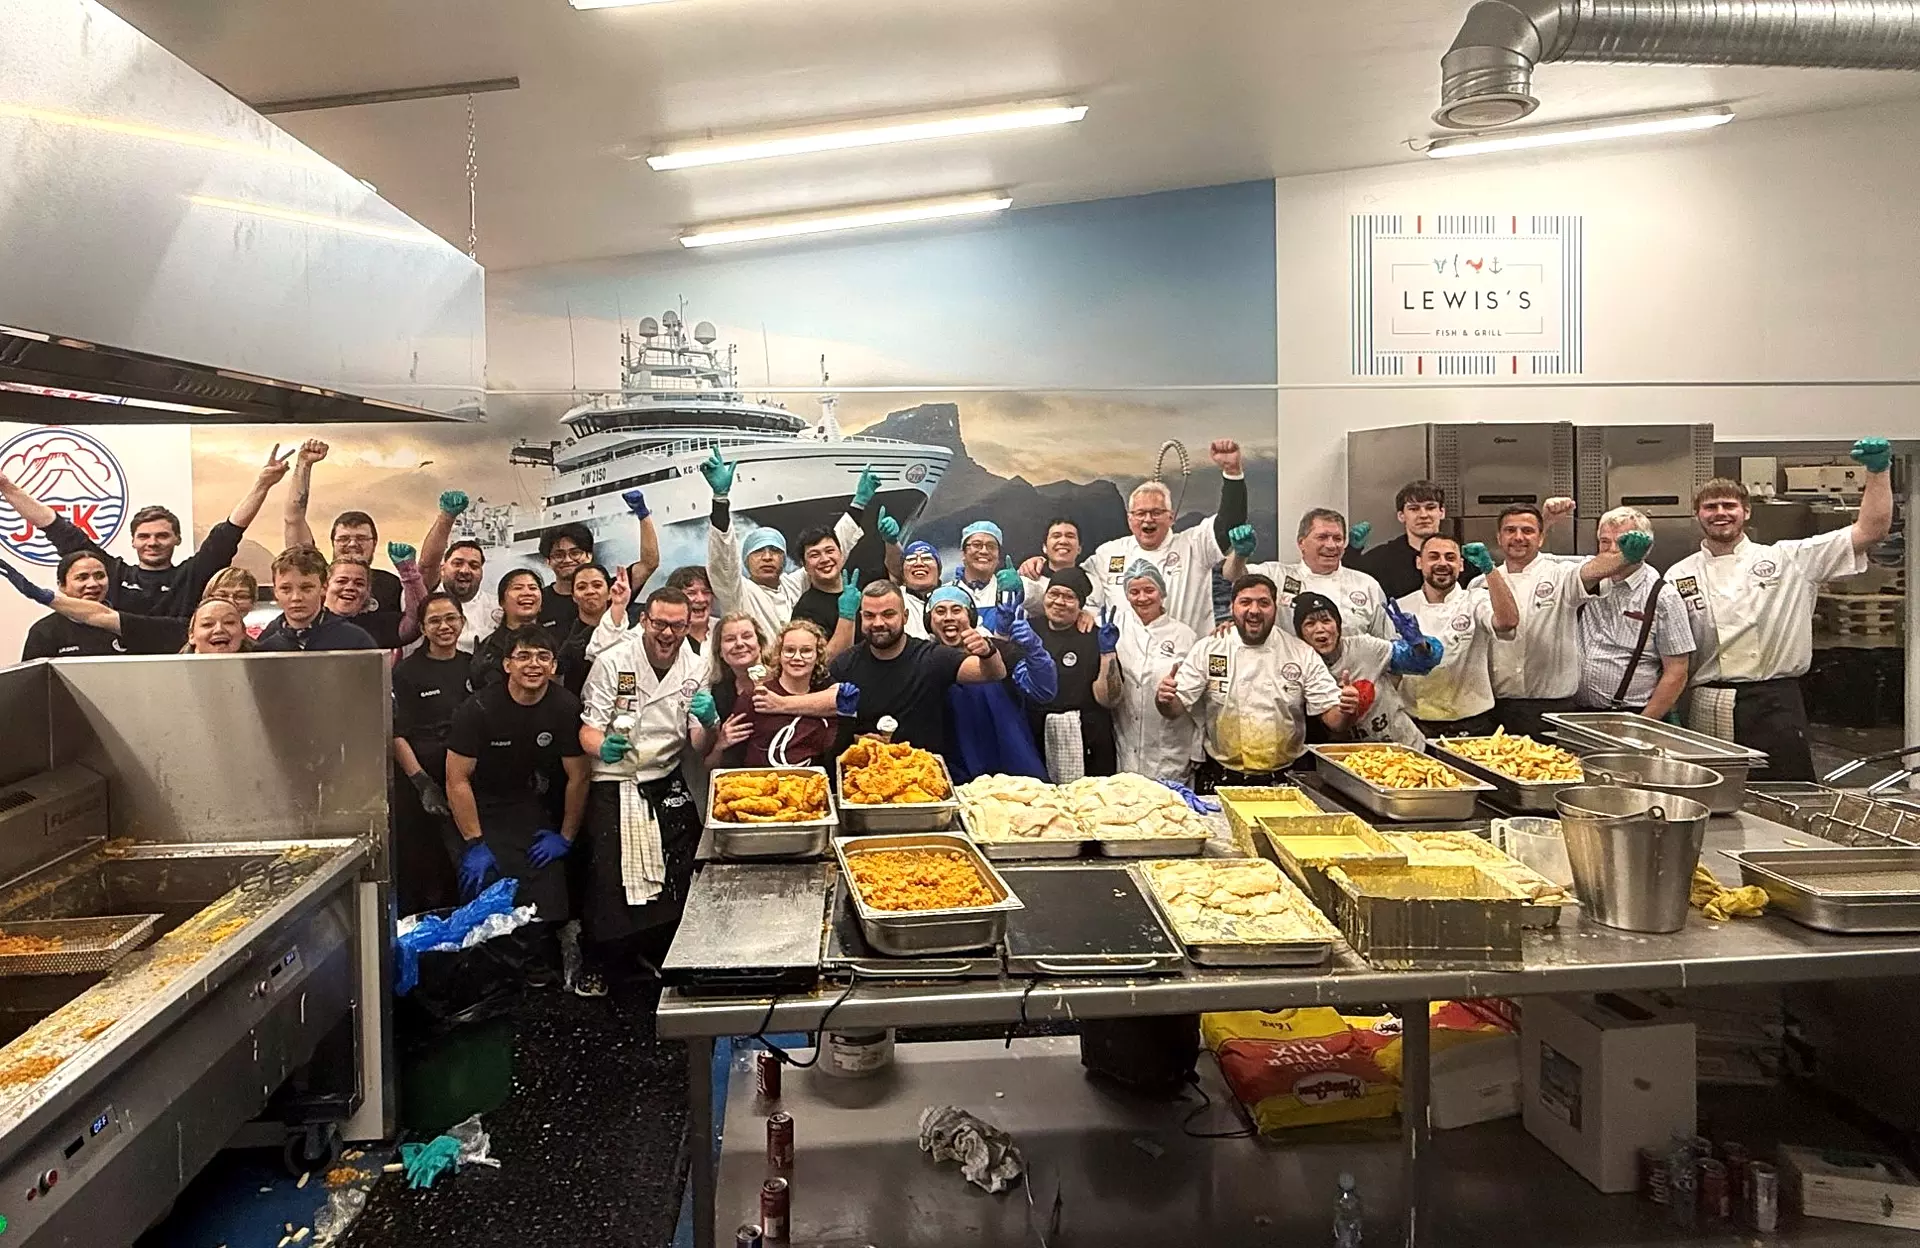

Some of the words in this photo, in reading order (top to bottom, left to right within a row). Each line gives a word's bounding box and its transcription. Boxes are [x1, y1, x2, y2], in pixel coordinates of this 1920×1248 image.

[1403, 290, 1531, 310] LEWIS'S
[592, 467, 607, 483] 2150
[683, 464, 701, 475] KG-1
[10, 504, 100, 542] JK
[1269, 1043, 1328, 1057] MIX
